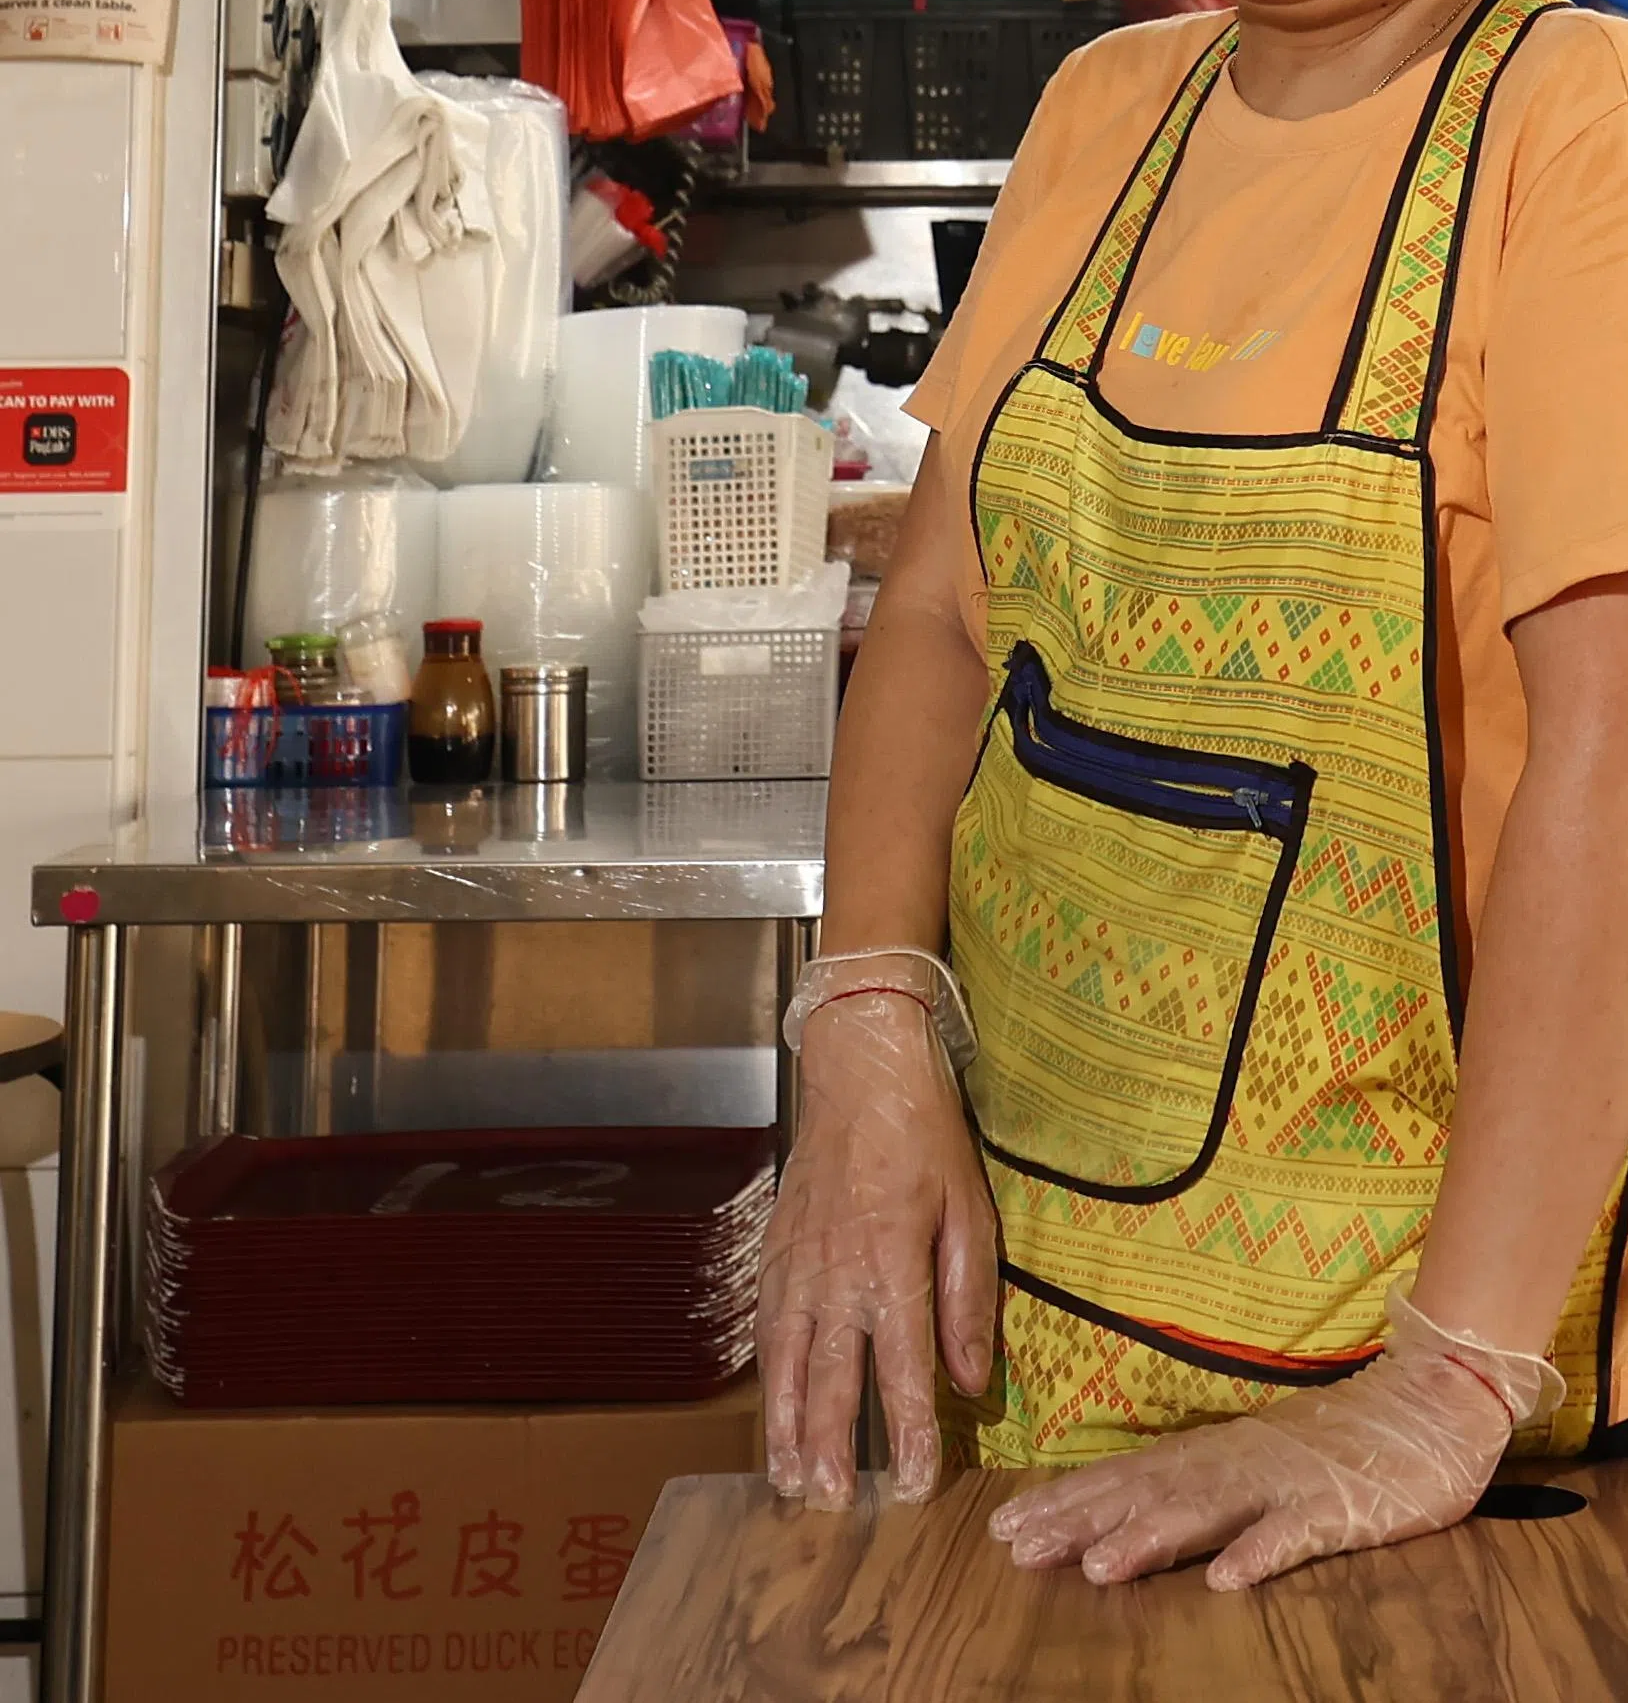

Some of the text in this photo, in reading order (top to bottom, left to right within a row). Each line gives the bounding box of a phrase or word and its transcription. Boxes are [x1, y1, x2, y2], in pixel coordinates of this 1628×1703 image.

[28, 395, 47, 408] TO
[49, 395, 75, 408] PAY
[77, 394, 116, 407] WITH
[228, 1489, 637, 1603] 松花皮蛋
[216, 1627, 602, 1676] PRESERVED DUCK EG
